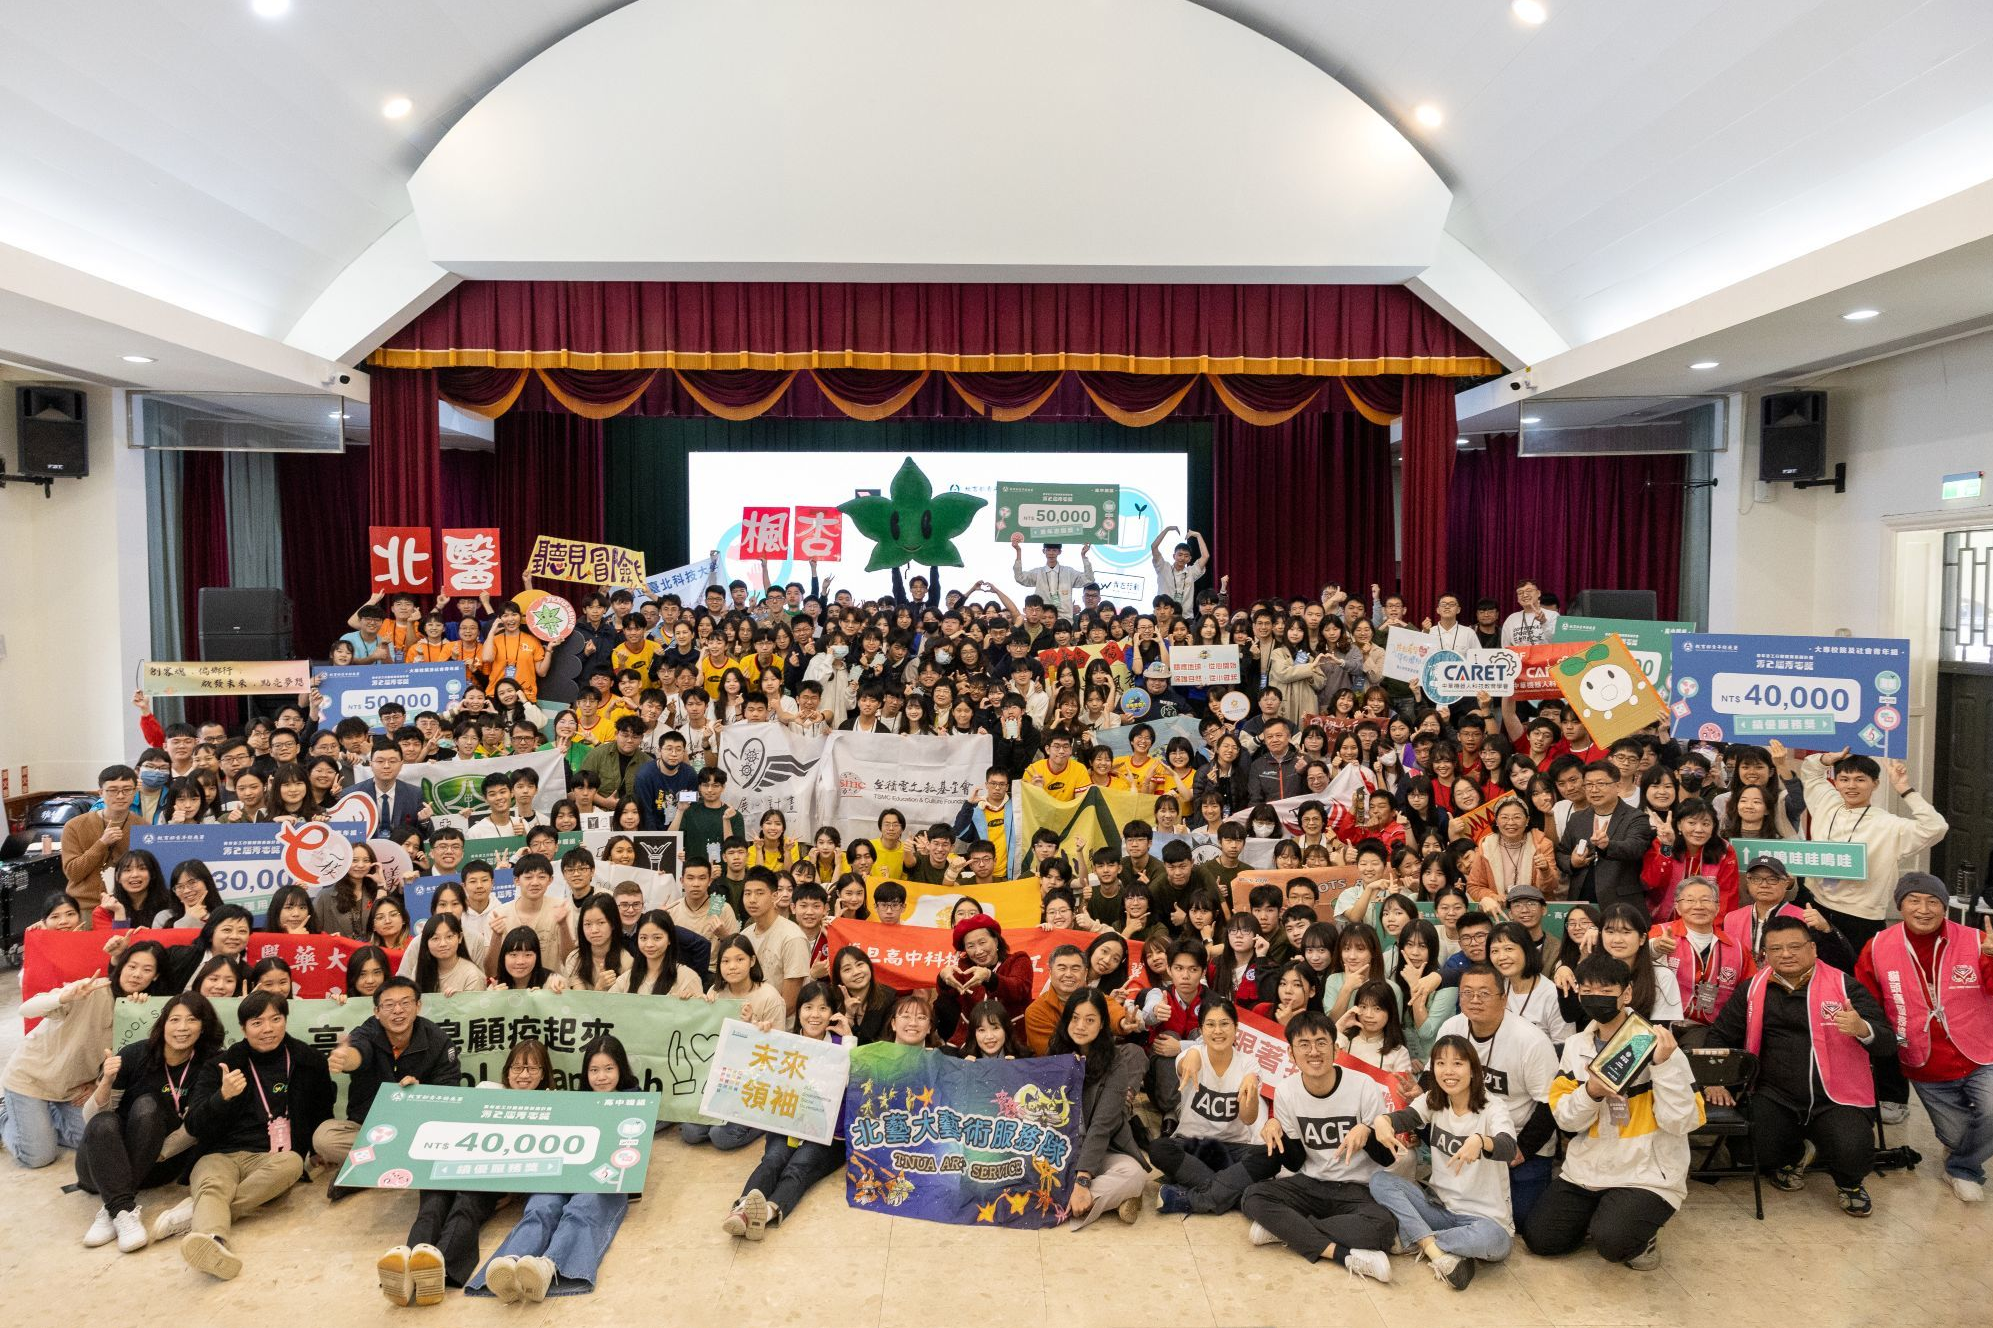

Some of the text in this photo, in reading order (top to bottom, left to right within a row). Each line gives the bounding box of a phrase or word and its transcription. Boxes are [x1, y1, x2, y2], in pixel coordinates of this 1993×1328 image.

[1036, 509, 1091, 525] 50,000
[741, 510, 788, 554] 楓
[796, 511, 840, 557] 杏
[373, 535, 430, 586] 北
[443, 534, 499, 591] 醫
[1444, 665, 1507, 681] CARET
[364, 693, 431, 710] 50000
[1721, 684, 1849, 711] NT$ 40,000
[840, 778, 867, 790] smc
[748, 1044, 809, 1080] 未來
[741, 1078, 799, 1119] 領袖
[1195, 1091, 1238, 1118] ACE
[423, 1132, 586, 1156] NT$ 40,000
[852, 1107, 1069, 1168] 北藝大藝術服務隊
[1436, 1133, 1463, 1154] AC
[893, 1152, 936, 1172] TNUA
[970, 1160, 1024, 1180] SERVICE
